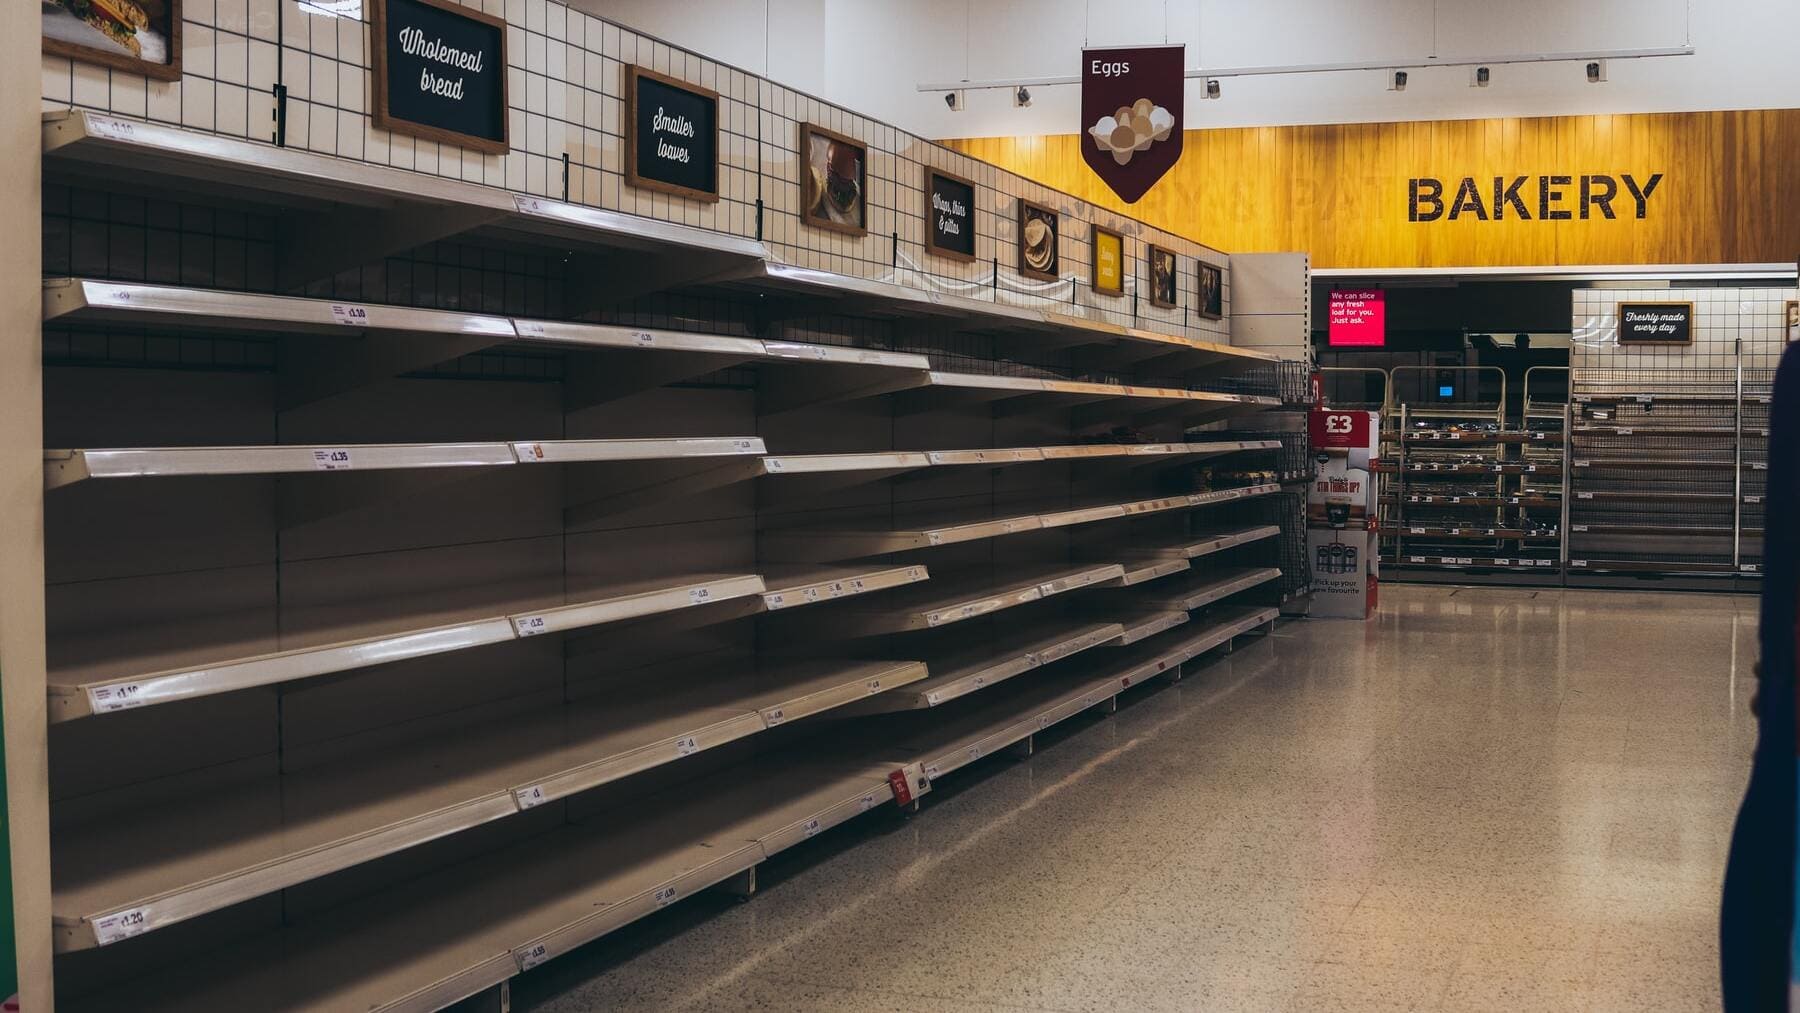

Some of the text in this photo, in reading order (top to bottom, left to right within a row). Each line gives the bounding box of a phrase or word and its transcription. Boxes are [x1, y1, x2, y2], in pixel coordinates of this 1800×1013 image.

[399, 26, 483, 73] Wholemeal
[1092, 60, 1130, 77] Eggs
[420, 67, 464, 101] bread
[652, 106, 695, 138] Smaller
[657, 137, 690, 164] loaves
[932, 192, 966, 217] Wraps, thins
[1408, 173, 1664, 222] BAKERY
[938, 215, 944, 230] &
[1625, 312, 1685, 323] Freshly made
[1634, 322, 1676, 334] every day
[1325, 415, 1352, 433] £3
[331, 451, 348, 461] £1.35
[1317, 481, 1329, 493] STIR
[1327, 586, 1360, 594] favourite
[121, 911, 144, 927] £1.20
